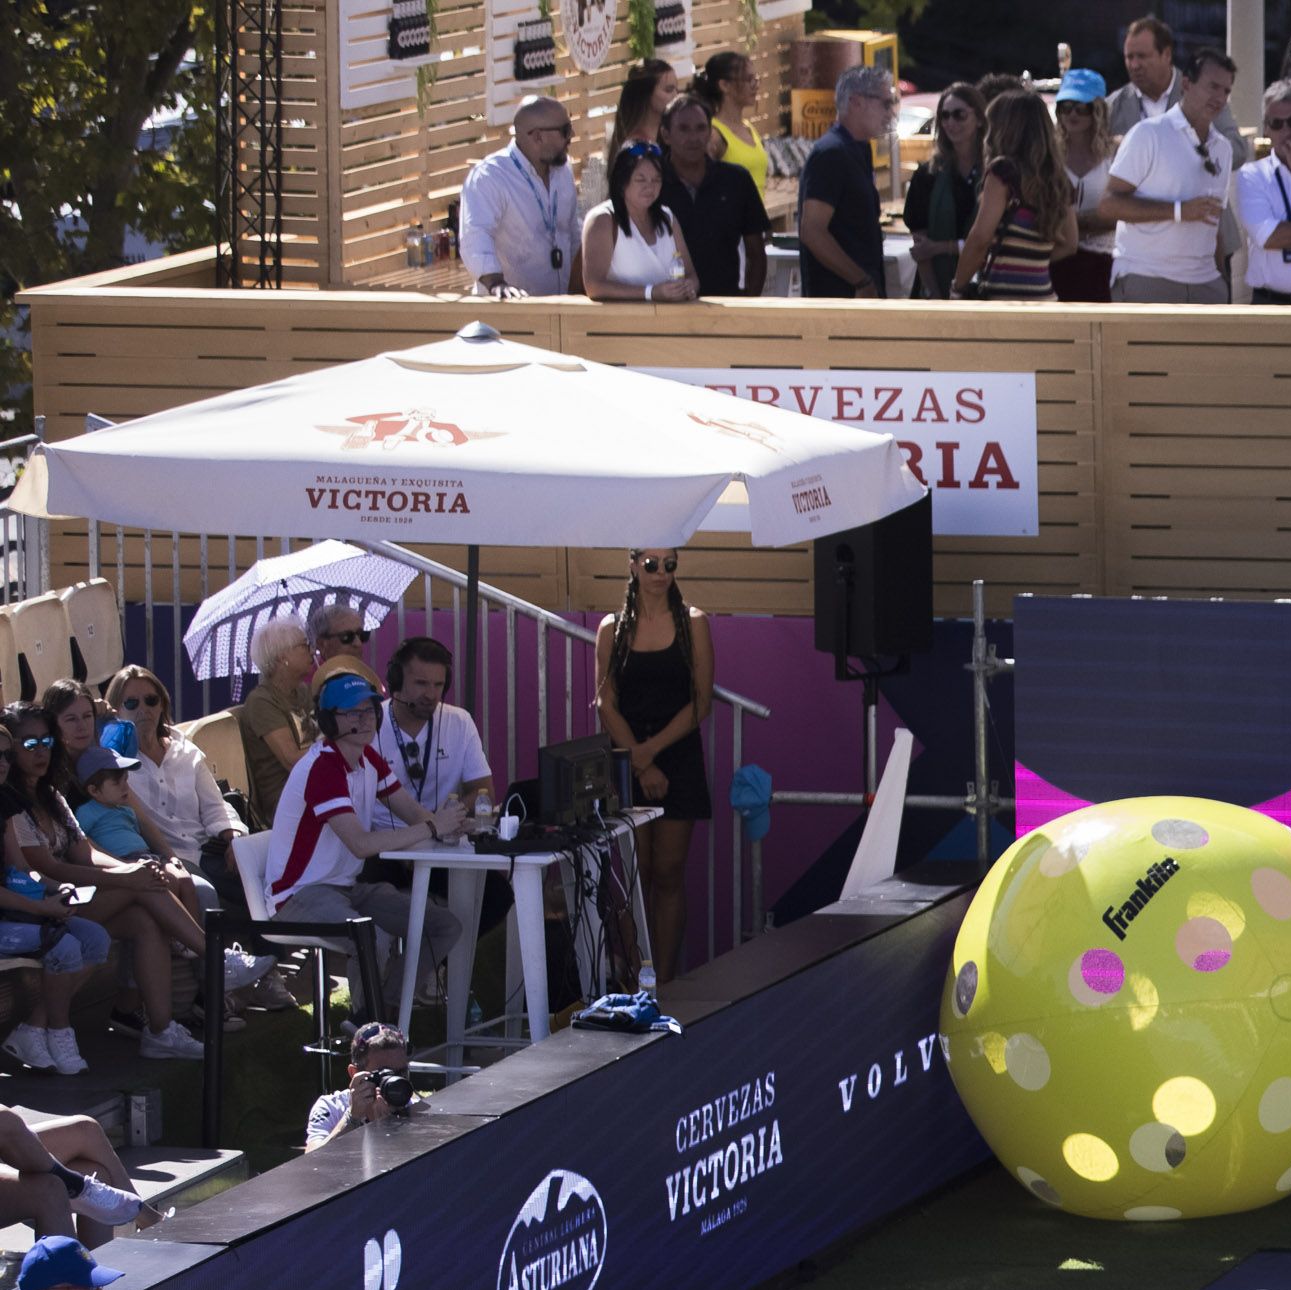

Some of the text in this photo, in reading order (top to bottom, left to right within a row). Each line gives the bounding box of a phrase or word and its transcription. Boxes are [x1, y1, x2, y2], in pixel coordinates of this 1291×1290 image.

[316, 475, 464, 488] MALAGUEÑA Y EXQUISITA
[305, 488, 471, 514] VICTORIA
[791, 483, 832, 515] VICTORIA
[360, 515, 392, 524] DESDE
[675, 1070, 776, 1154] CERVEZAS
[665, 1118, 784, 1223] VICTORIA
